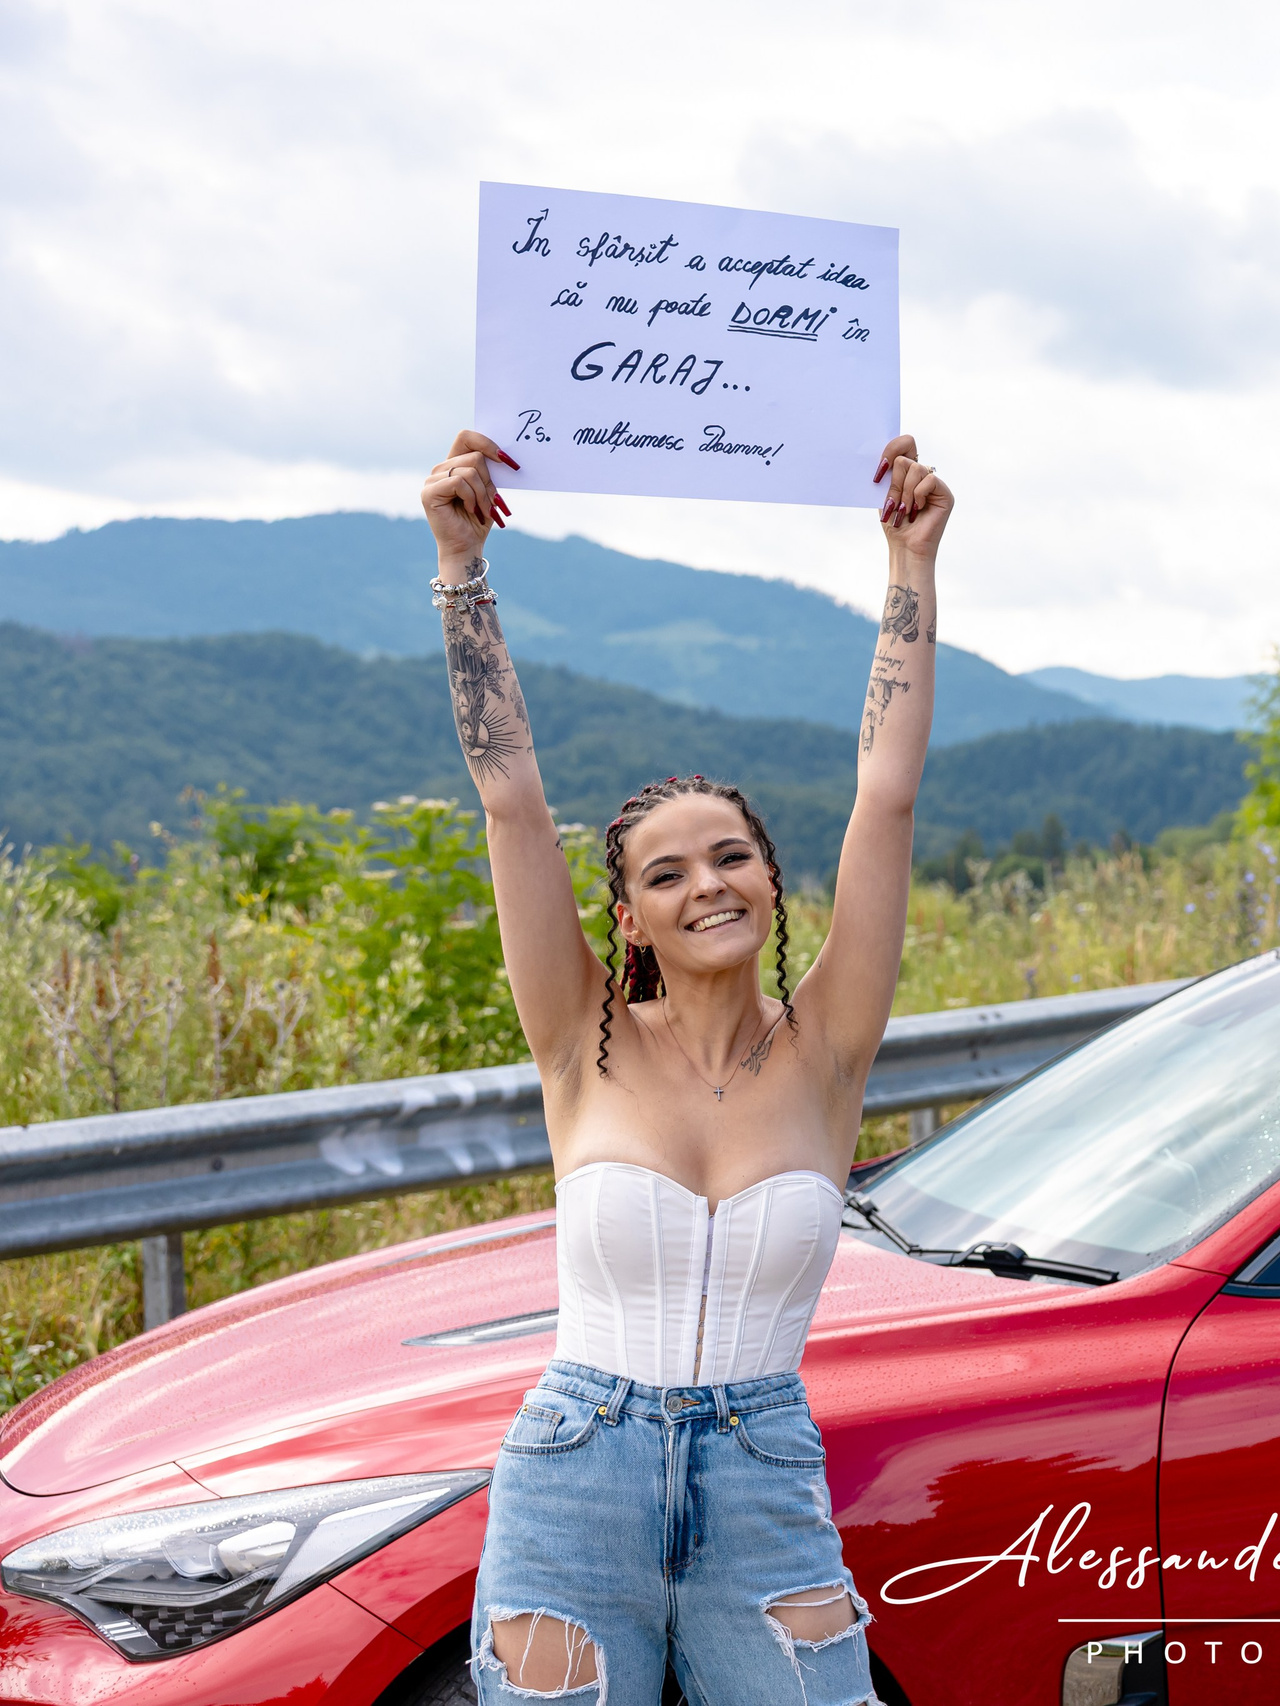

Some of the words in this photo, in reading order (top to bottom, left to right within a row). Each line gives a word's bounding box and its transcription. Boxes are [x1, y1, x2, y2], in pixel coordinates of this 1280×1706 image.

[512, 208, 551, 258] În
[576, 231, 679, 268] sfârșit
[684, 254, 707, 272] a
[718, 254, 816, 291] acceptat
[816, 262, 871, 291] idea
[550, 281, 588, 308] că
[605, 295, 639, 315] nu
[647, 292, 712, 328] poate
[841, 317, 871, 343] în
[573, 420, 685, 454] mulțumesc
[698, 424, 785, 466] Doamne!
